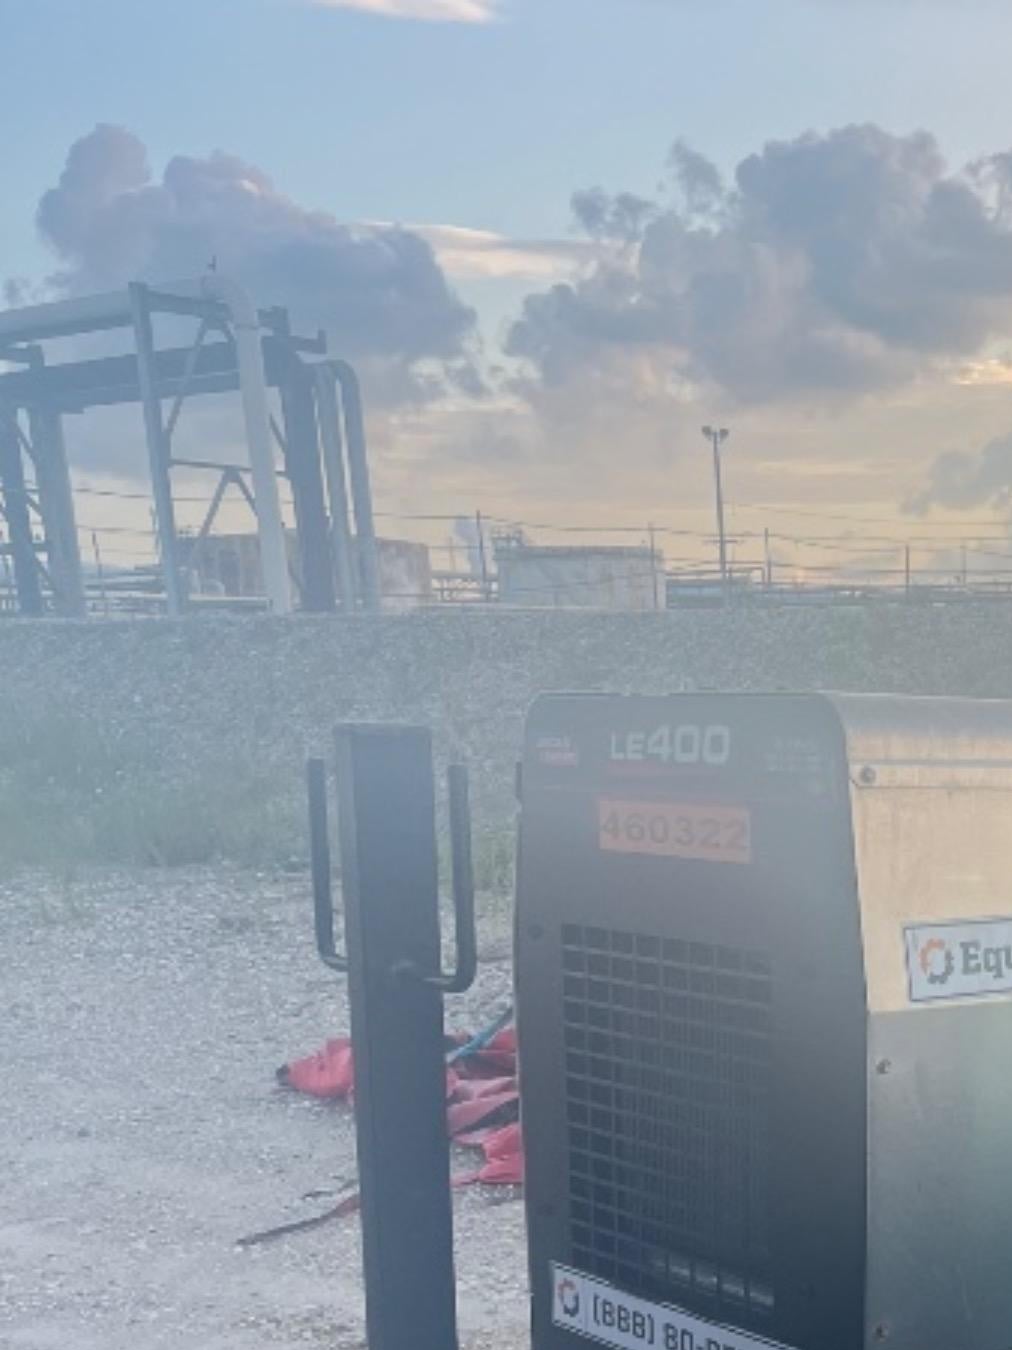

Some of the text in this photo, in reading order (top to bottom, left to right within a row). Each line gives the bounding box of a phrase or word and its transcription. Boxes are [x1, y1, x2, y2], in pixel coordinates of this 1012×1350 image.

[610, 724, 731, 764] LE400
[602, 809, 748, 850] 460322
[593, 1293, 655, 1345] (888)
